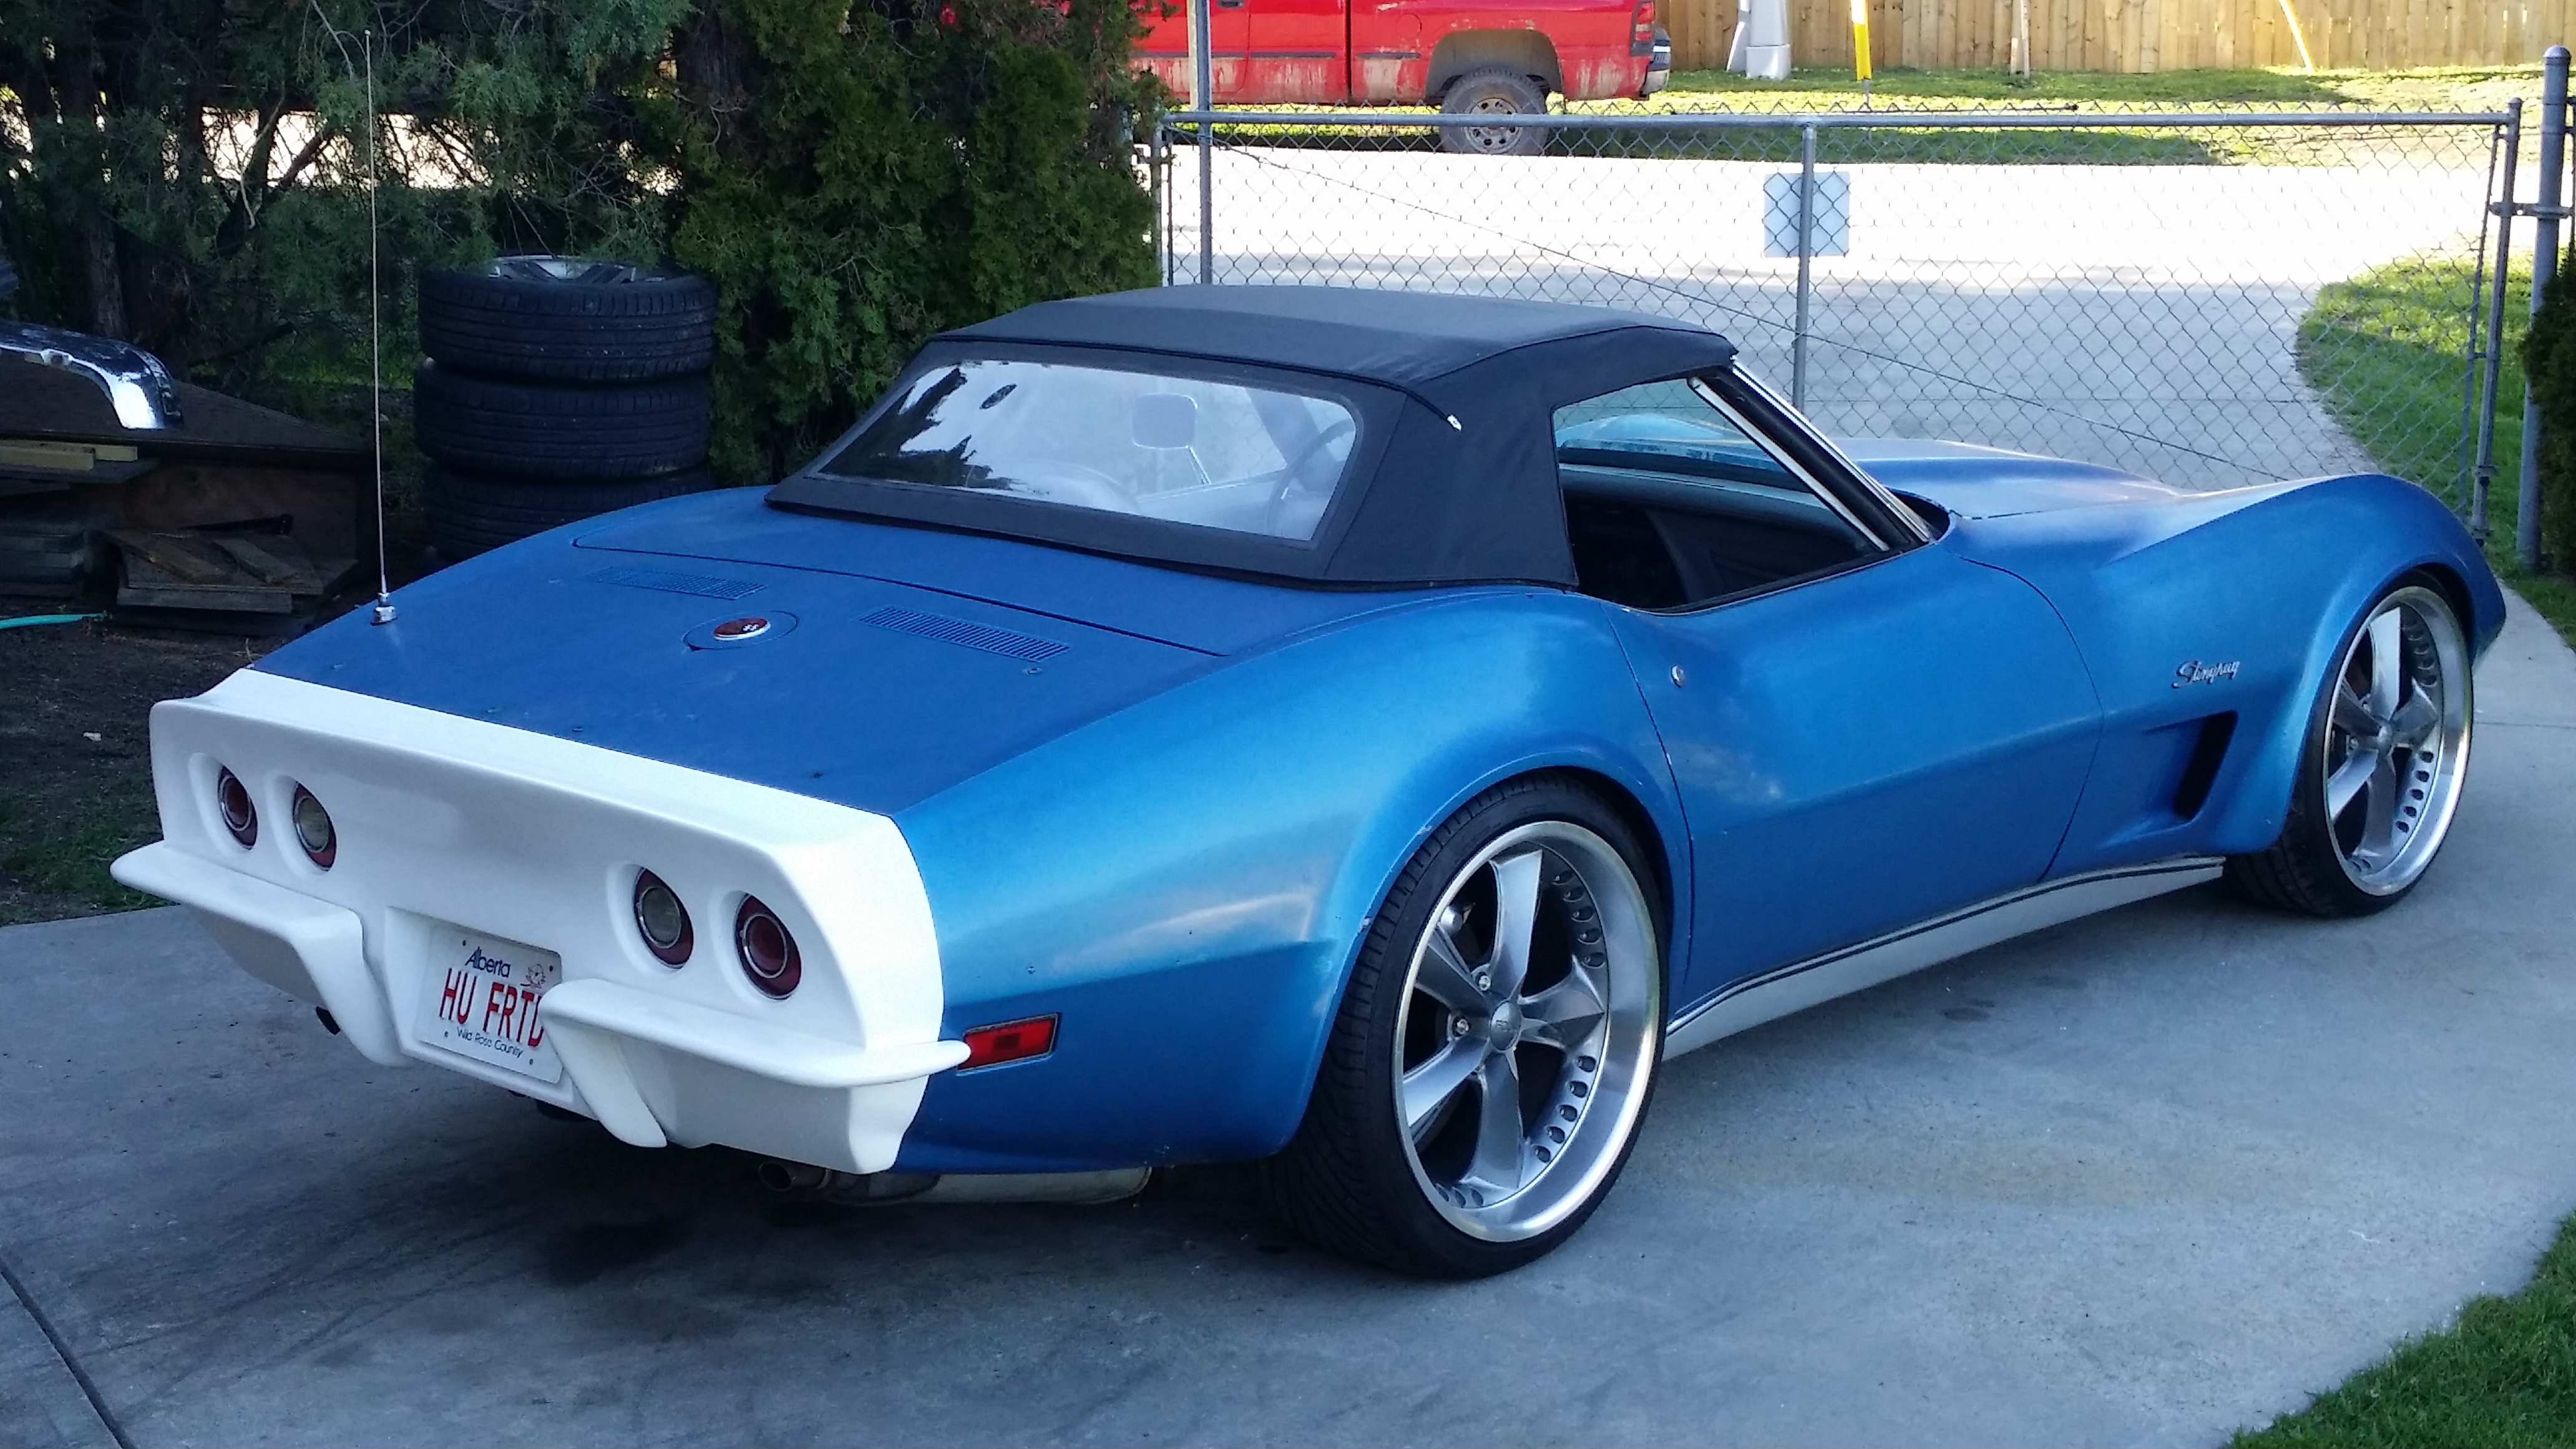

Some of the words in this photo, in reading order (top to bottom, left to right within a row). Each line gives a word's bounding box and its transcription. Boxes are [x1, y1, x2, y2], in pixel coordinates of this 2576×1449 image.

[2171, 660, 2240, 688] Stingray
[465, 946, 511, 978] Alberta
[439, 968, 477, 1025] HU
